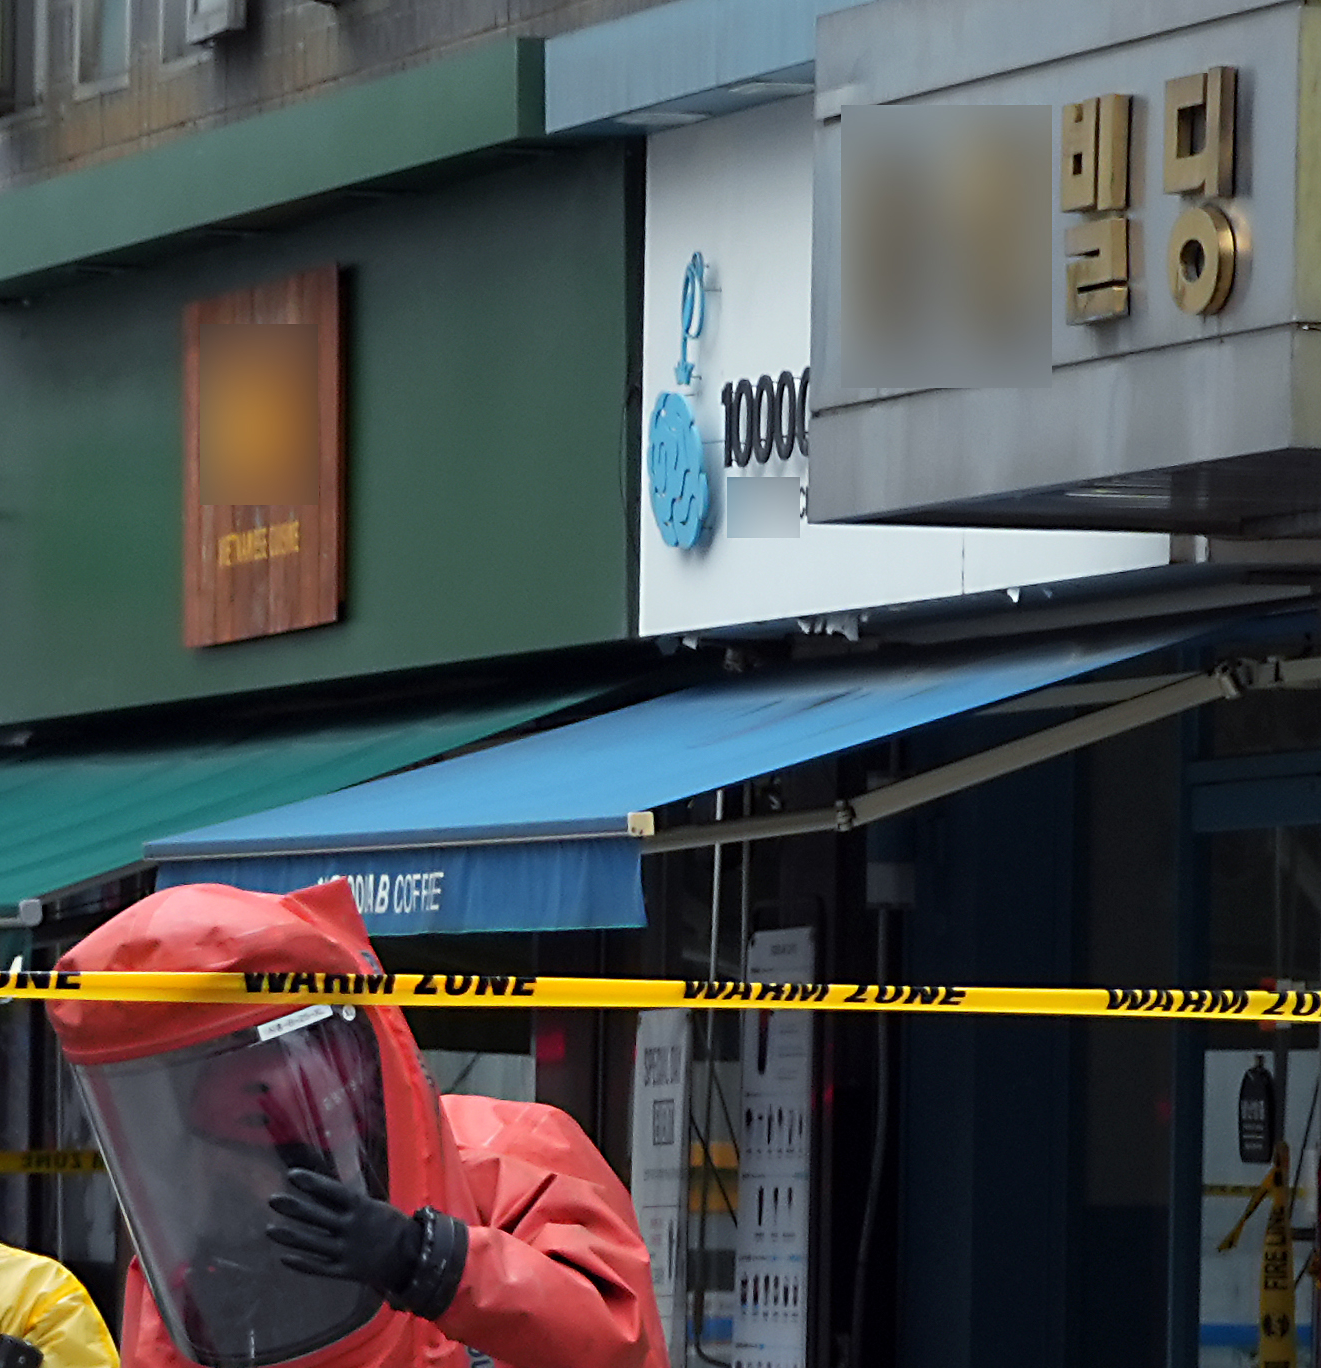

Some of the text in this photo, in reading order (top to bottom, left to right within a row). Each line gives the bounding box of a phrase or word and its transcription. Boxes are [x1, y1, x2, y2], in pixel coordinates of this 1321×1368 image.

[1060, 64, 1240, 328] 빌딩
[244, 972, 537, 997] WARM ZONE
[683, 980, 967, 1006] WARM ZONE
[1106, 987, 1321, 1017] WARM ZO
[1262, 1251, 1290, 1291] FIRE
